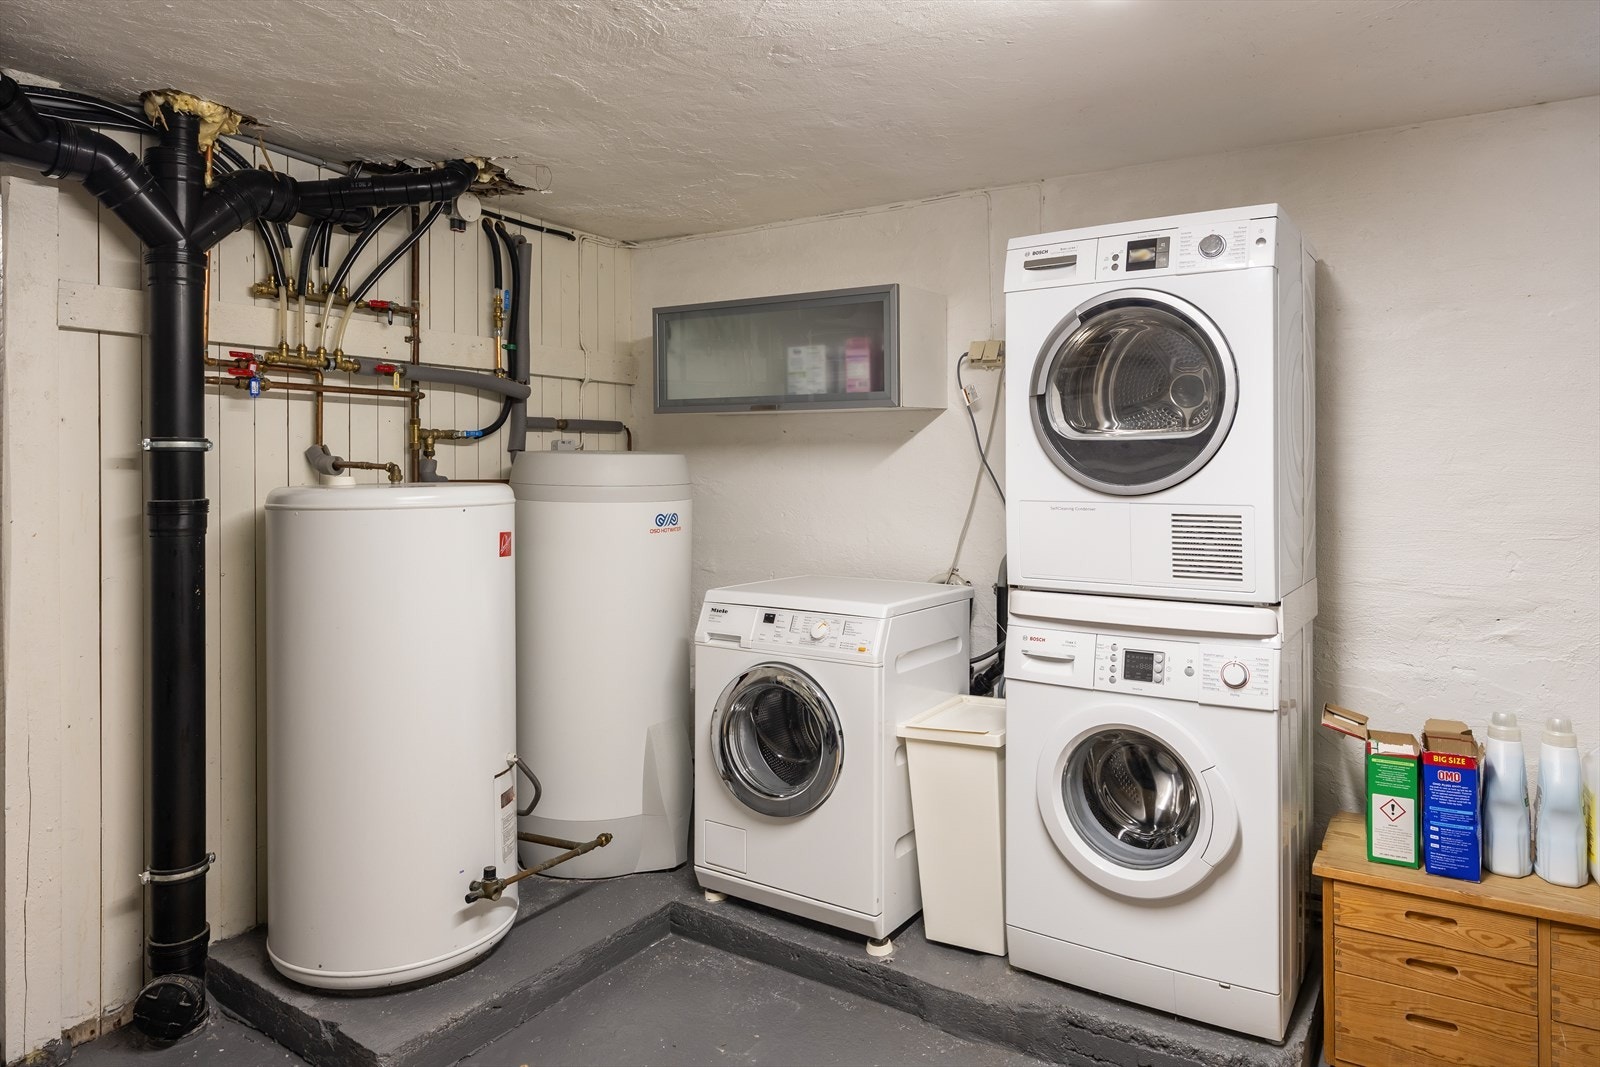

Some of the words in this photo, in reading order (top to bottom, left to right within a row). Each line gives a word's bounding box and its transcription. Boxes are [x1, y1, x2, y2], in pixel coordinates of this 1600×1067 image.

[1433, 755, 1447, 763] BIG
[1448, 757, 1466, 765] SIZE
[1438, 770, 1461, 782] OMO
